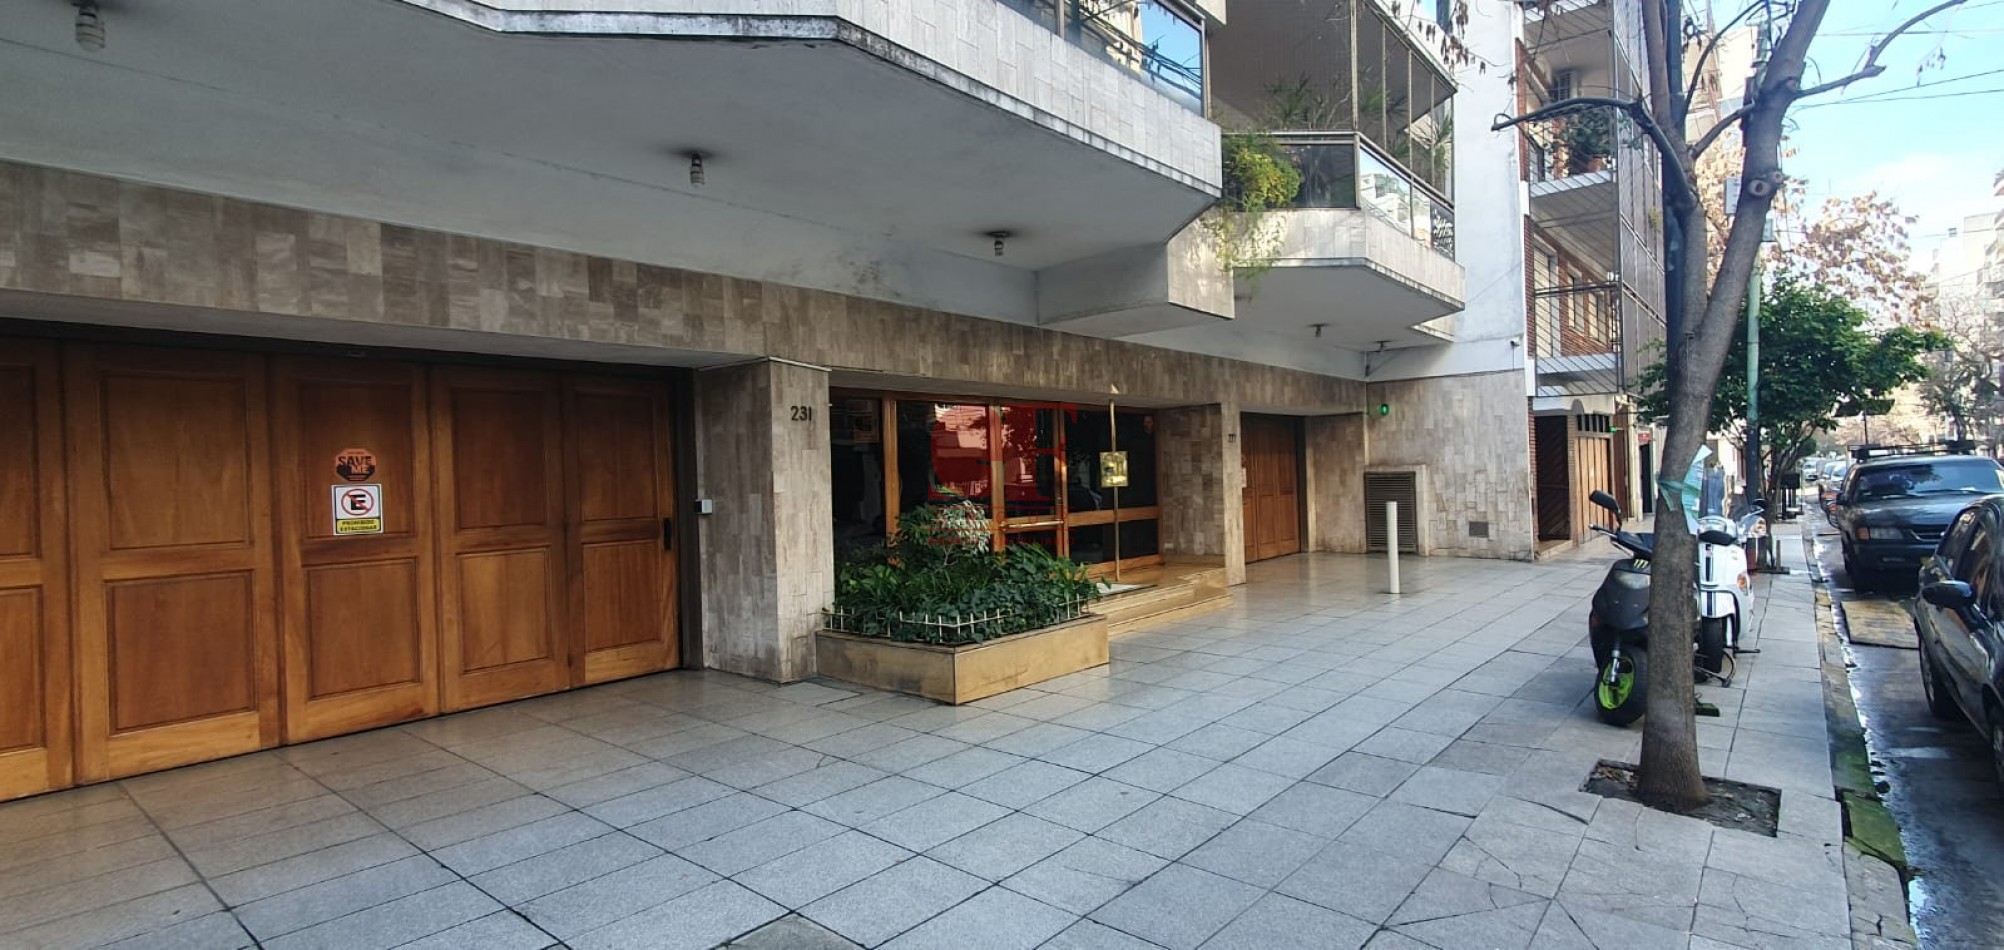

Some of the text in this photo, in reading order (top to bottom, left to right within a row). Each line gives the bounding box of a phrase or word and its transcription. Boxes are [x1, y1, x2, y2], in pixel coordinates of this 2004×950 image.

[790, 405, 812, 422] 231
[339, 456, 372, 467] SAVE
[351, 466, 369, 474] ME
